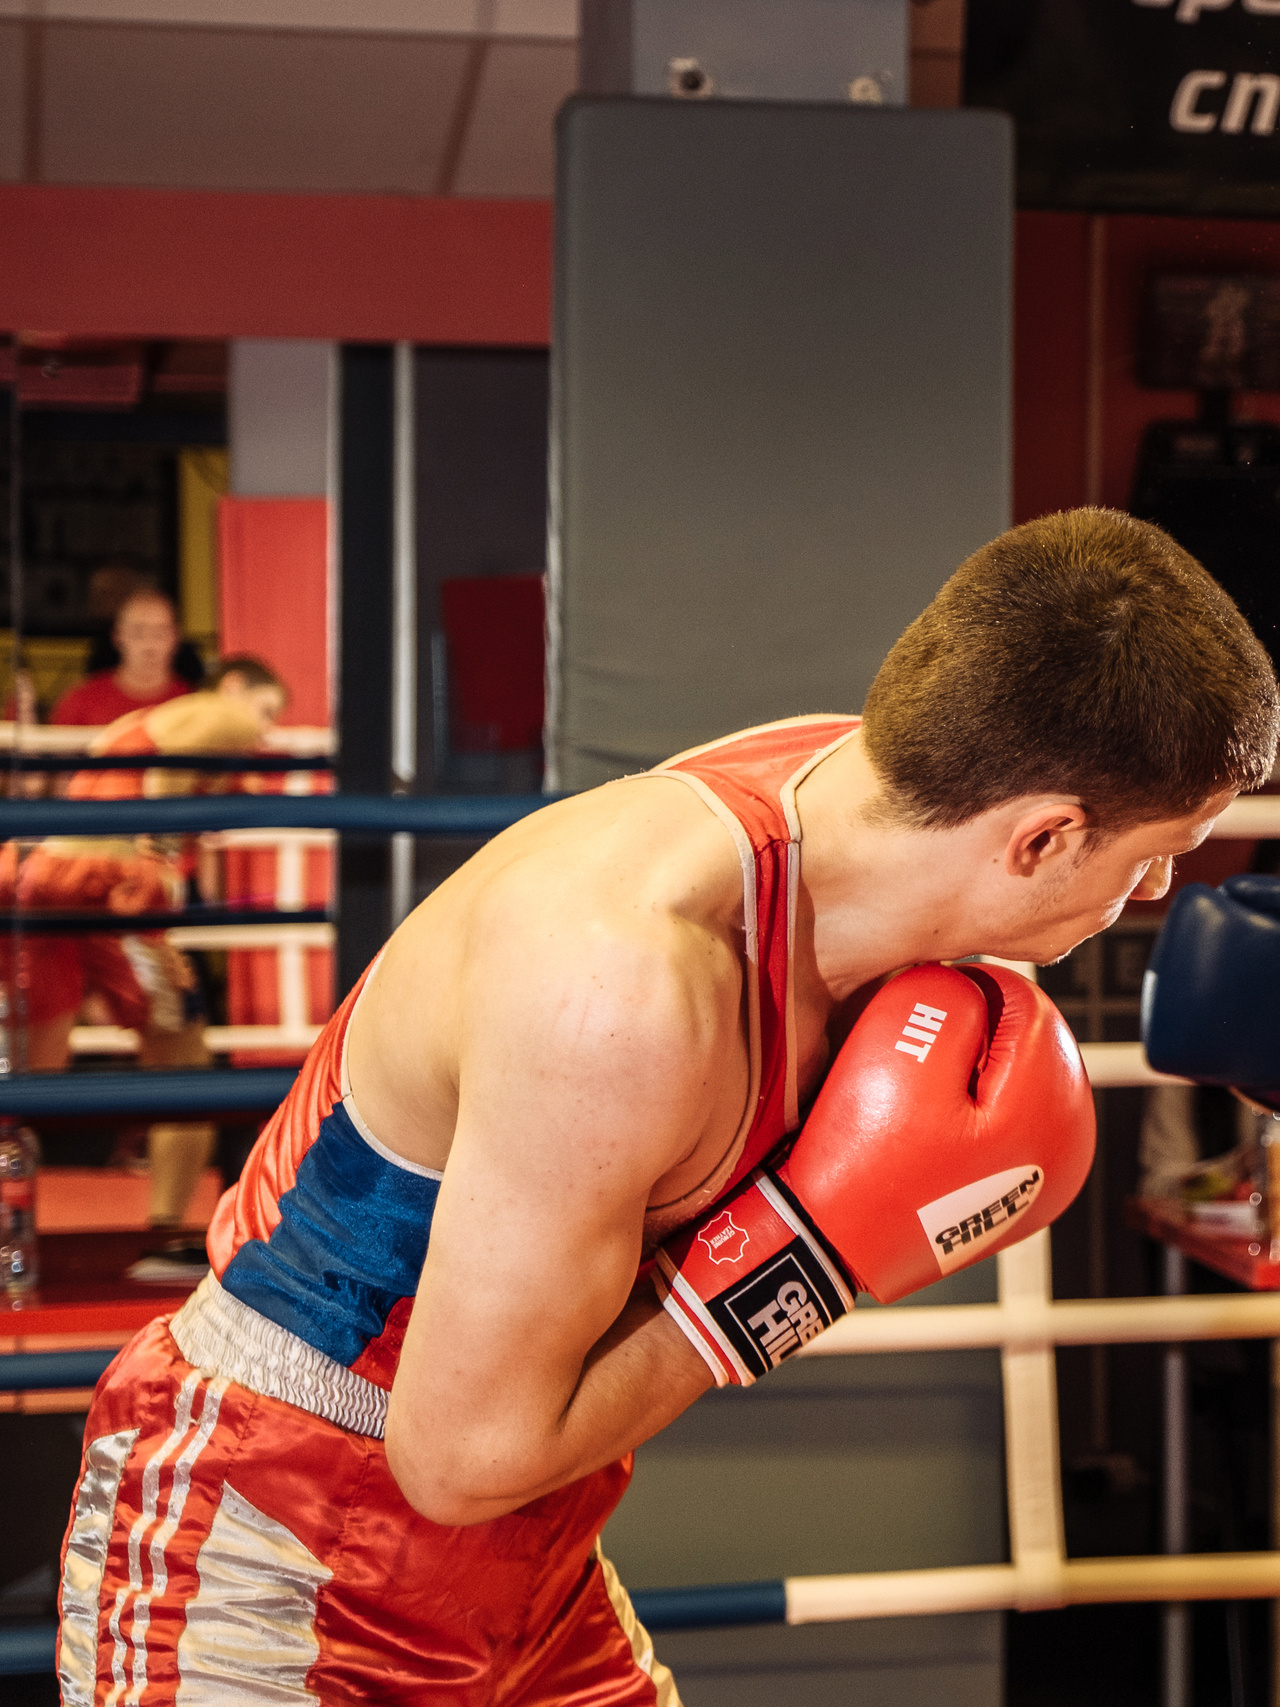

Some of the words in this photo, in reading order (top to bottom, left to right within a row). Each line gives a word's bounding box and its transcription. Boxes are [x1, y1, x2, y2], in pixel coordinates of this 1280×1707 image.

[895, 1002, 947, 1063] HIT
[935, 1170, 1040, 1244] GREEN
[942, 1200, 1029, 1255] HILL
